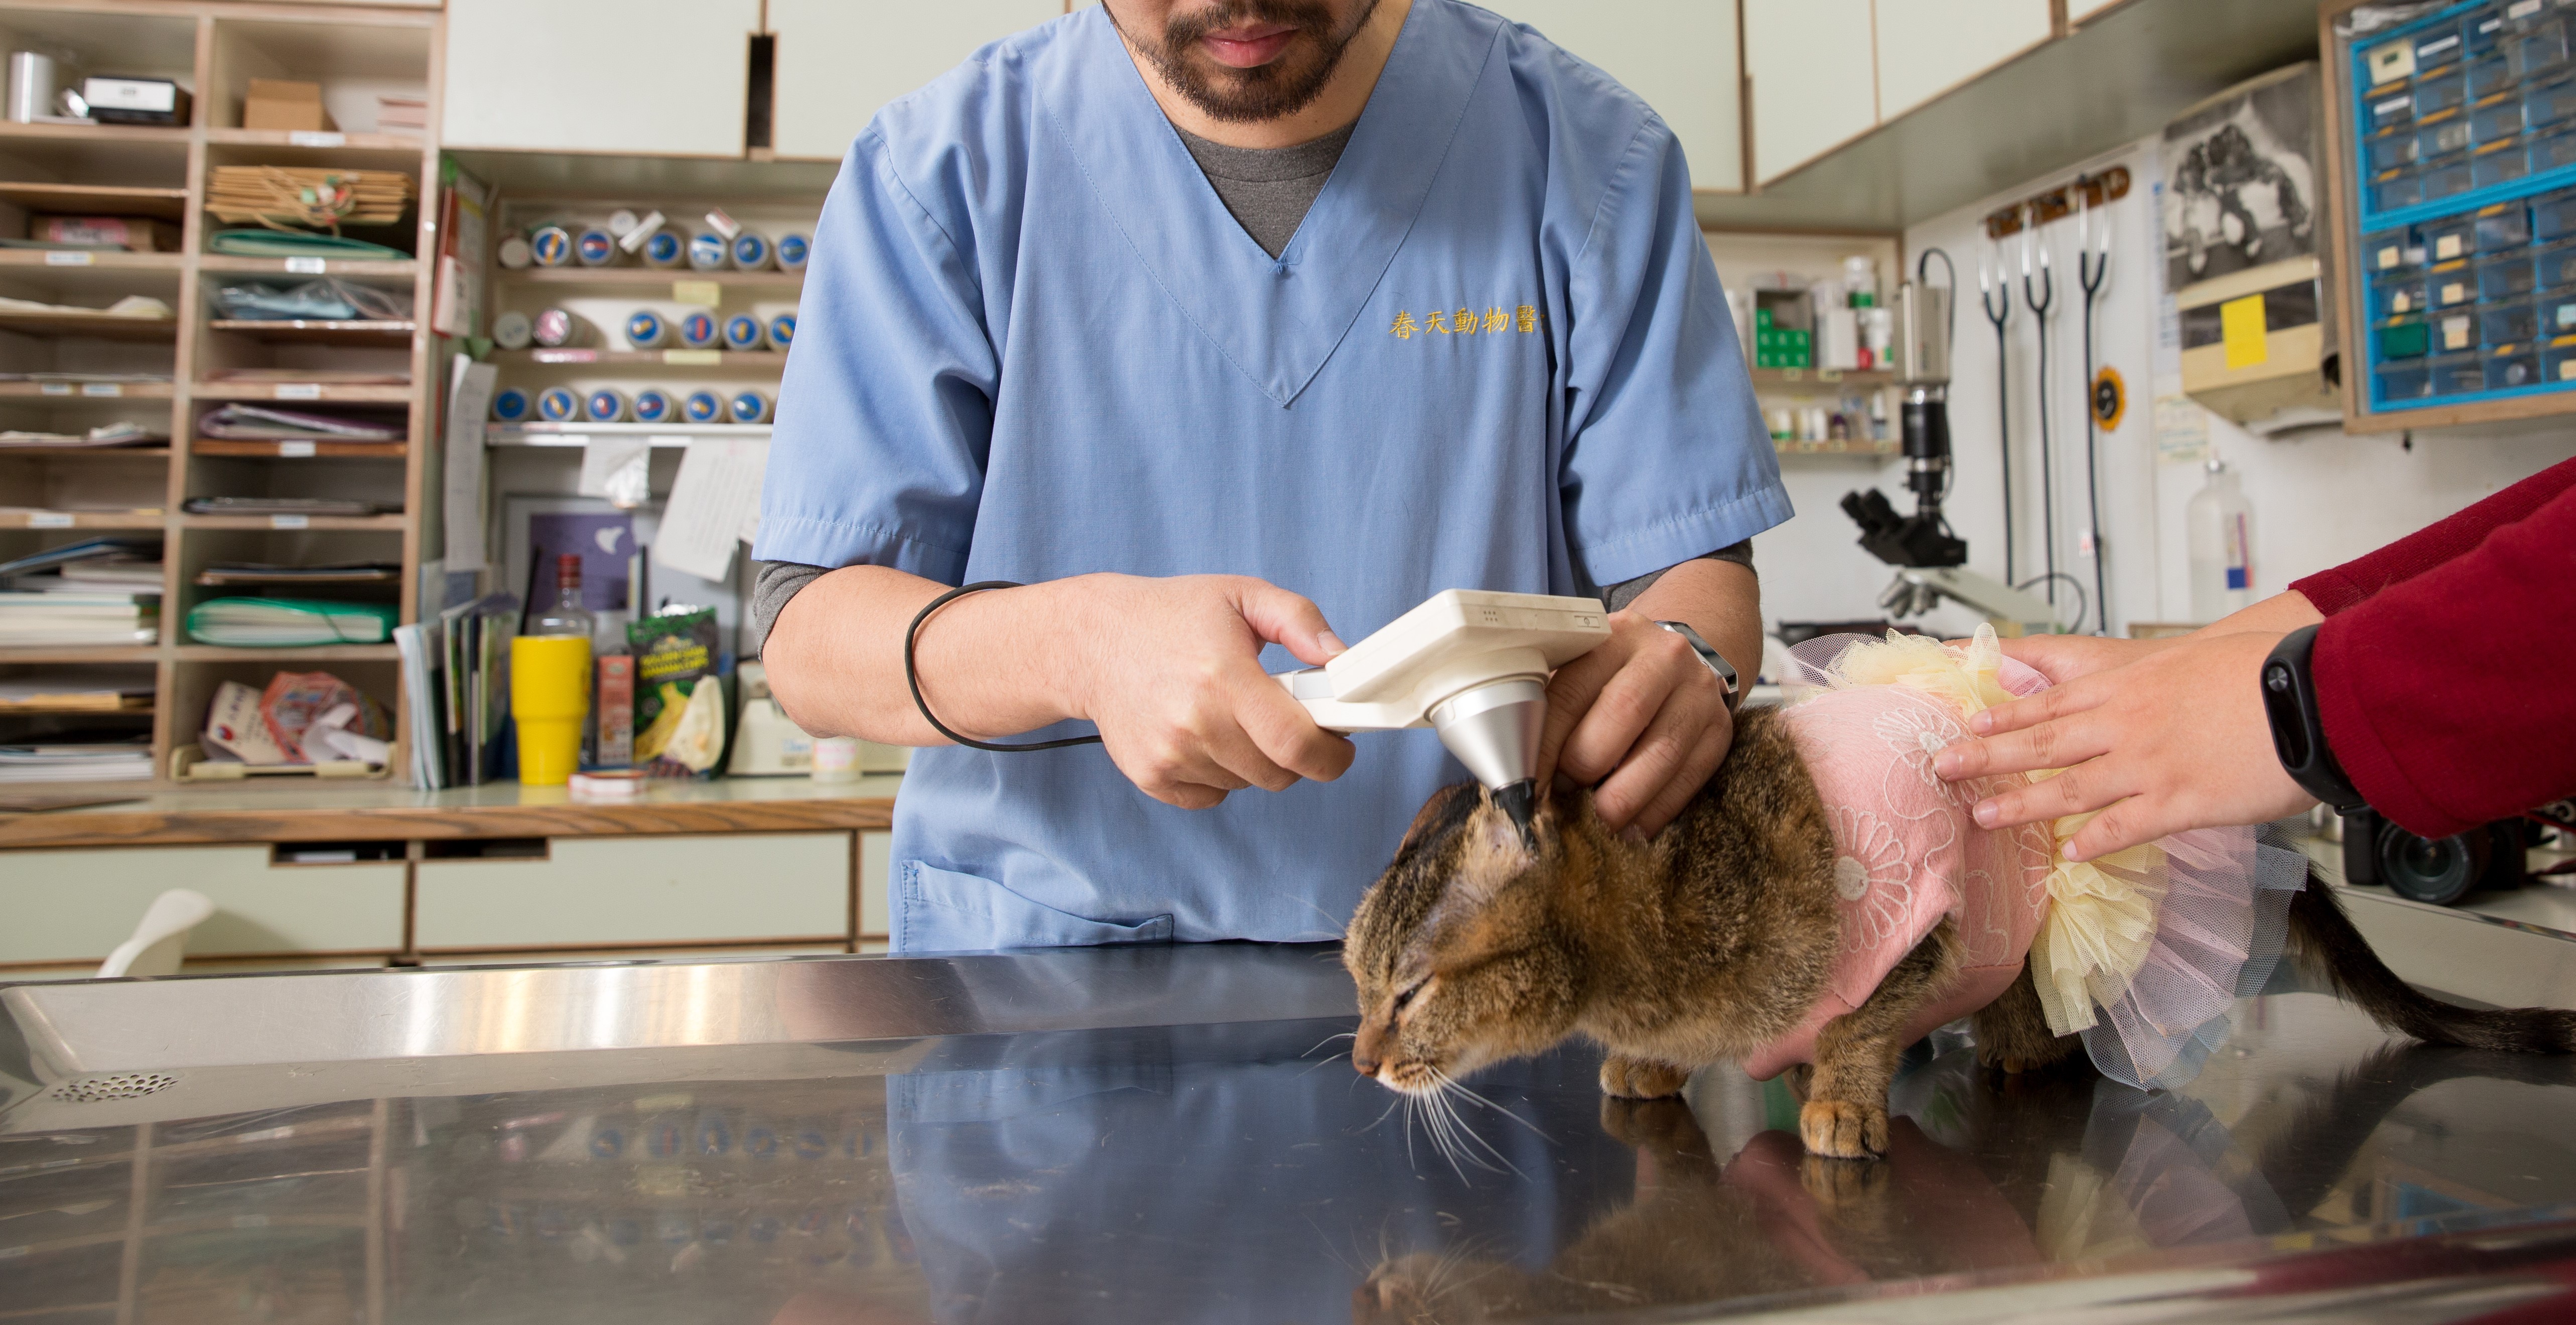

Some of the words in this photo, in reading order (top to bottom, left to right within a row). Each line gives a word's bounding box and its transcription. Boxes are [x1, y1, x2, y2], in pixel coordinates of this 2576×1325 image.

[1388, 305, 1544, 339] 春天動物醫
